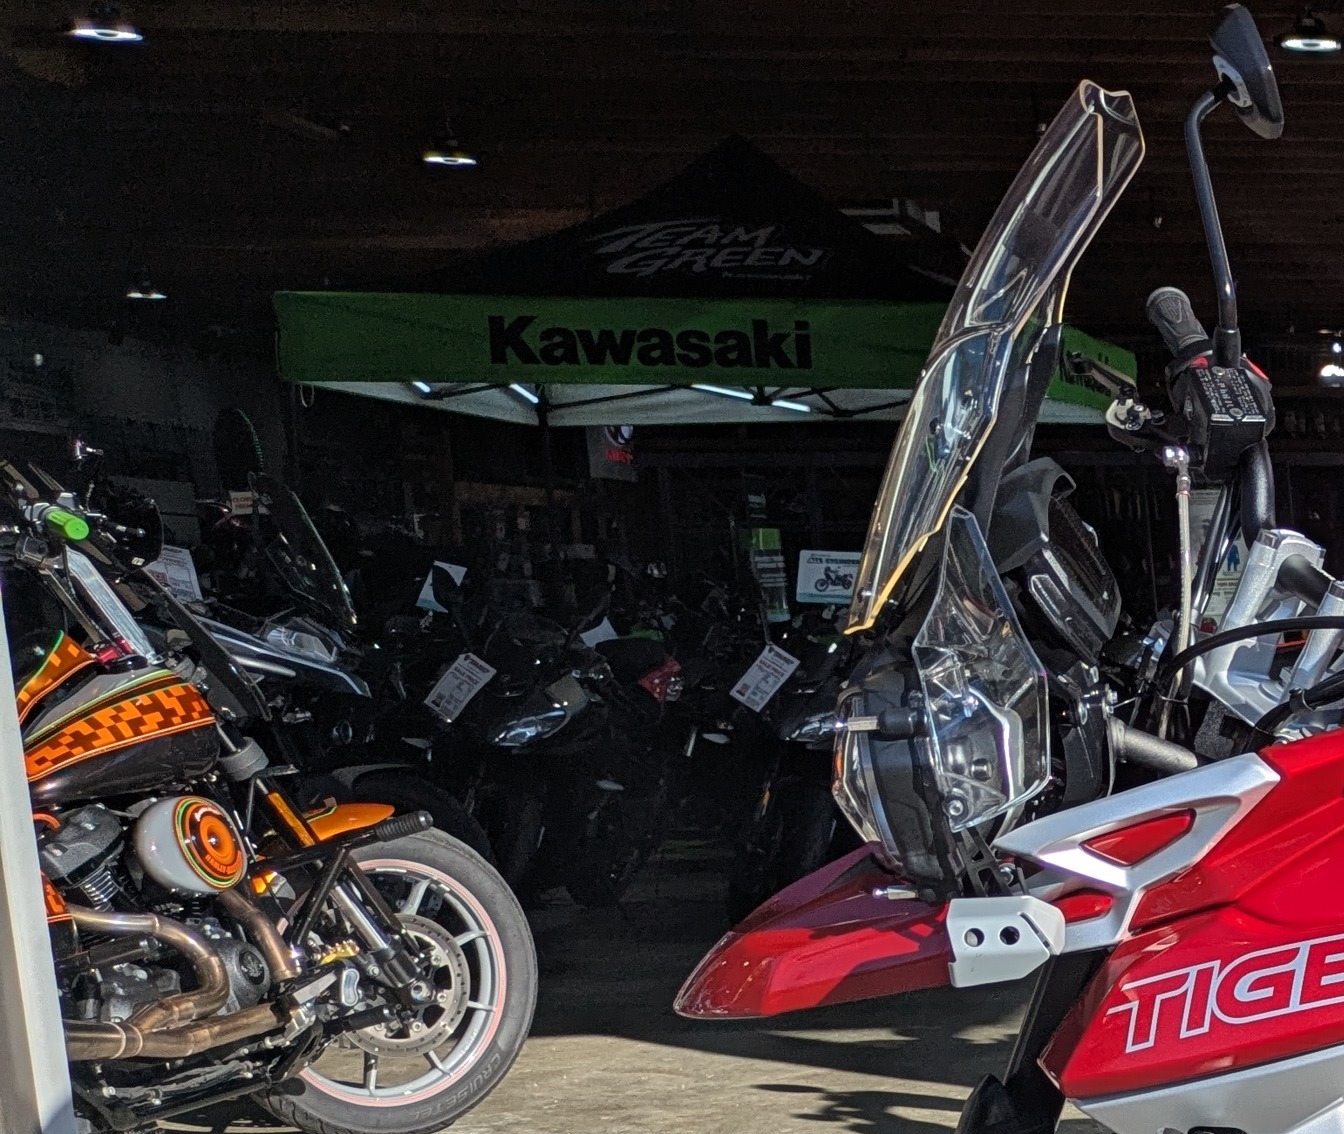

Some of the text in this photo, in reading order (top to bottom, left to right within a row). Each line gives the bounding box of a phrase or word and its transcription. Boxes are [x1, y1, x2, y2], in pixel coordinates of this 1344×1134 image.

[585, 218, 779, 255] TEAM
[606, 246, 826, 279] GREEN
[487, 315, 812, 369] Kawasaki
